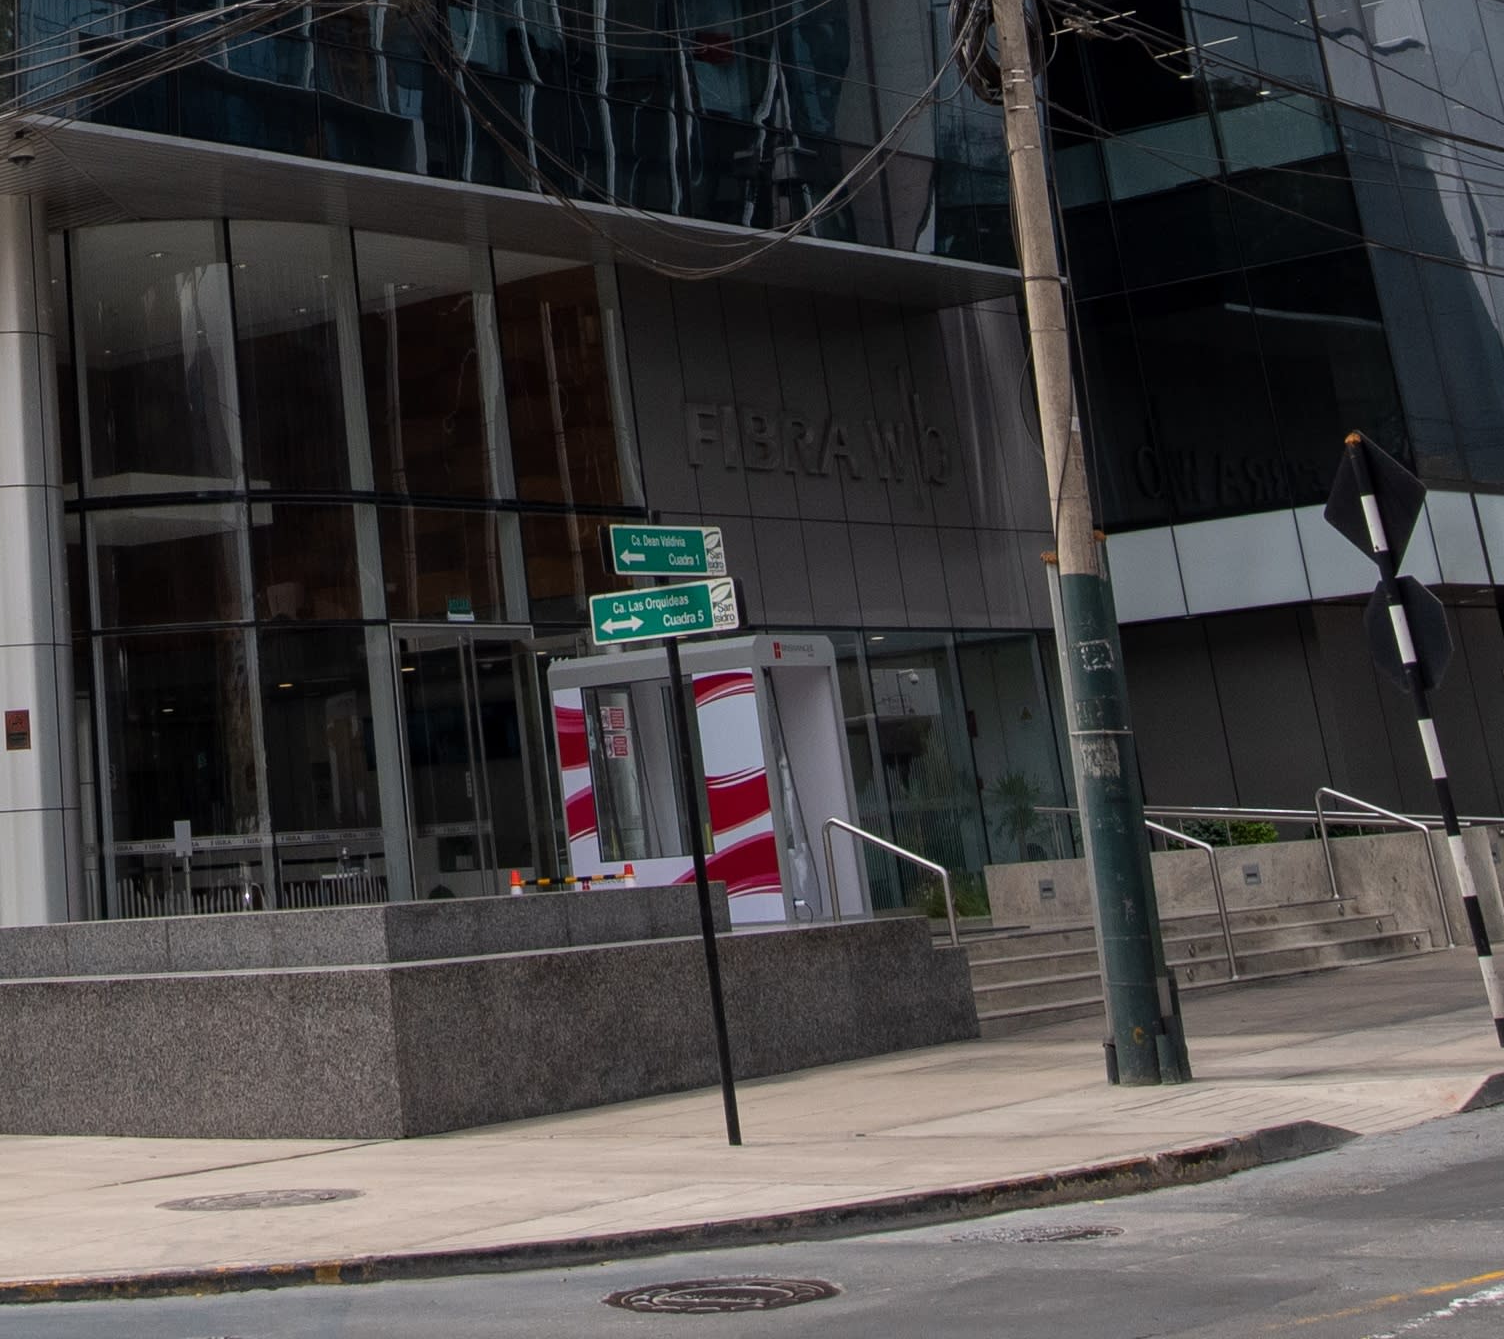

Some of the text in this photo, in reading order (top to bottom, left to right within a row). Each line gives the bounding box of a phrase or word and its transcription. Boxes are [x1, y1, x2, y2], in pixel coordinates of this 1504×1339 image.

[660, 536, 686, 548] Valdivia
[668, 553, 700, 566] Cuadra 1
[709, 550, 723, 560] San
[612, 601, 627, 614] Ca.
[628, 599, 644, 612] Las
[717, 602, 734, 613] San
[663, 610, 705, 627] Cuadra 5
[714, 611, 736, 623] Isidro
